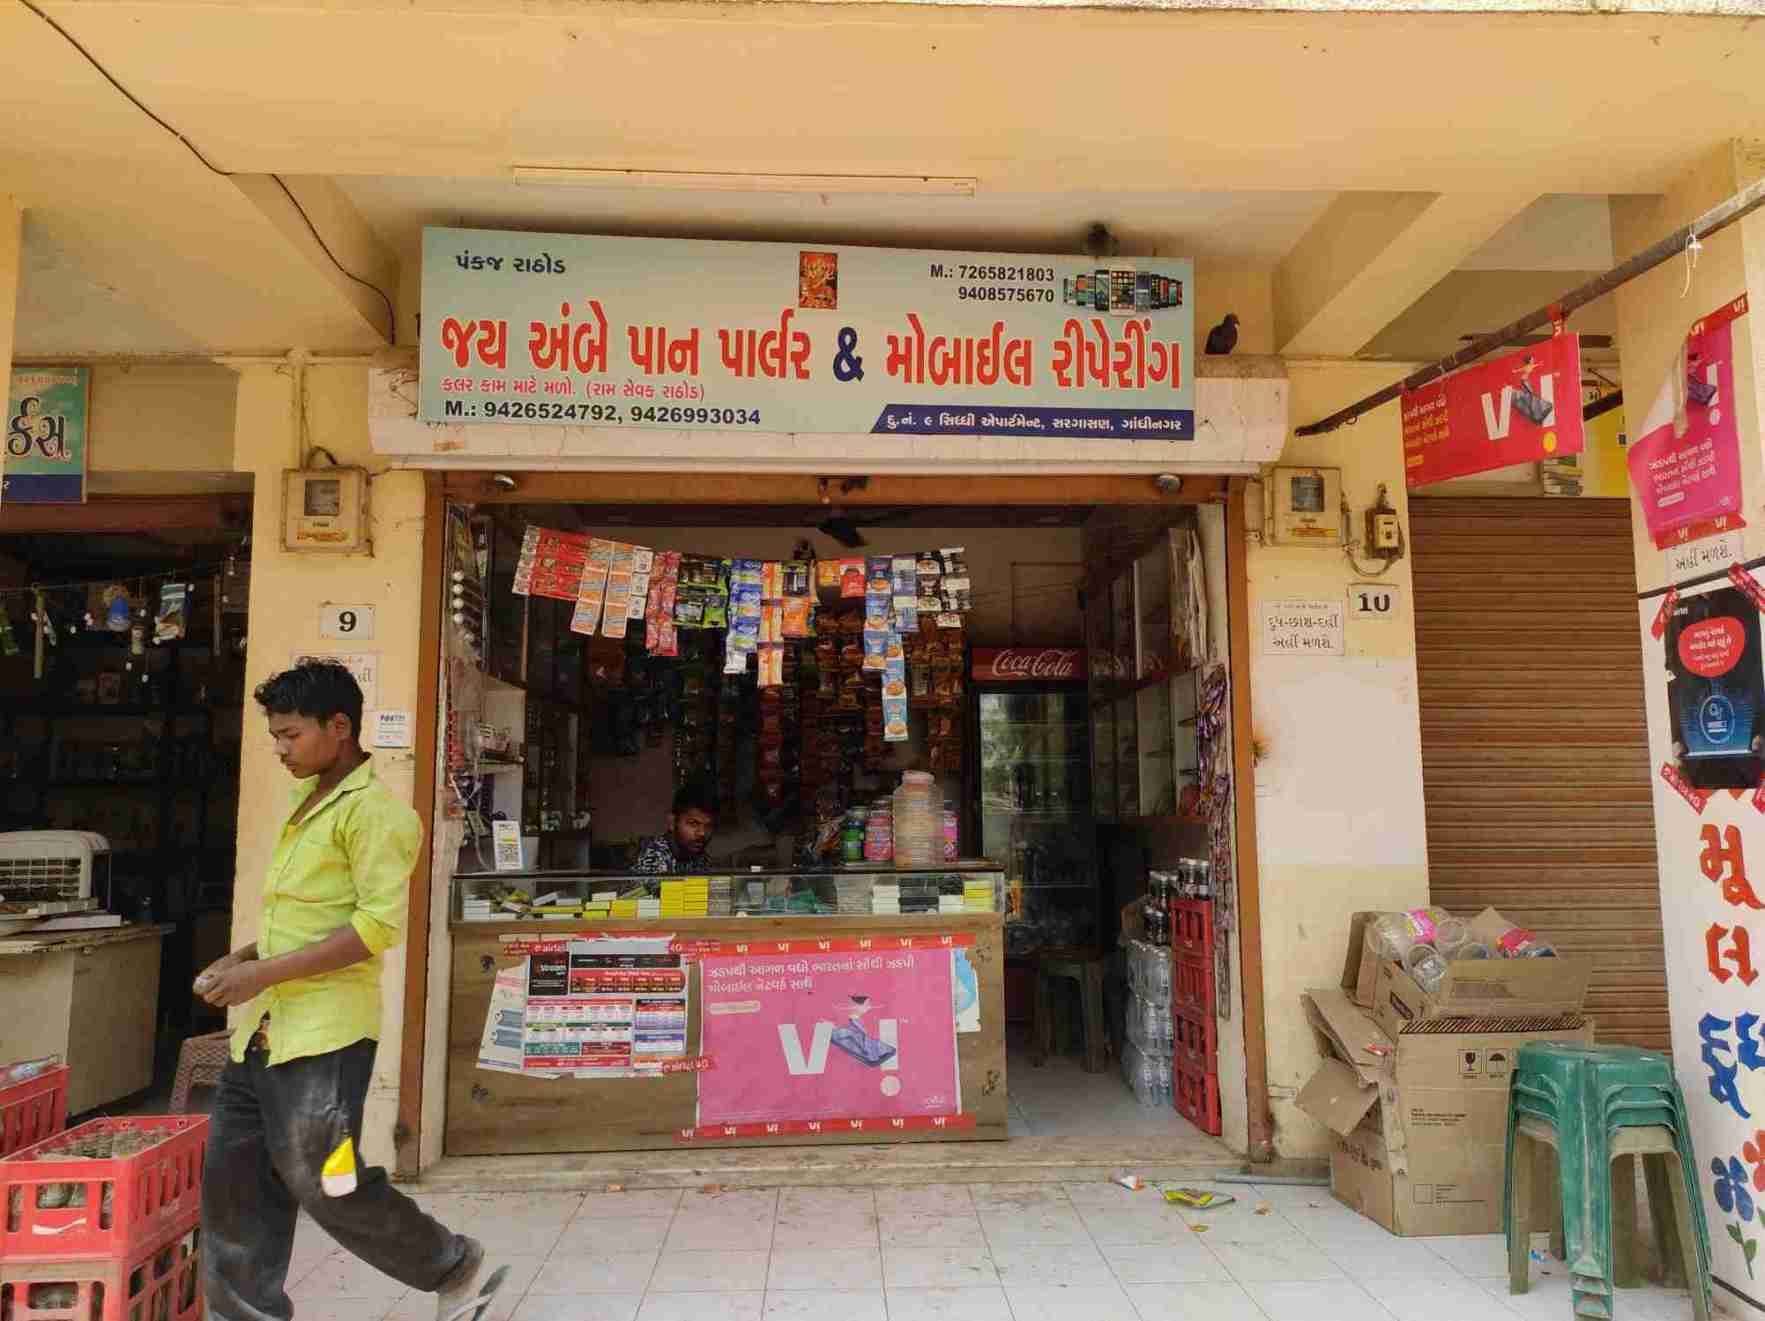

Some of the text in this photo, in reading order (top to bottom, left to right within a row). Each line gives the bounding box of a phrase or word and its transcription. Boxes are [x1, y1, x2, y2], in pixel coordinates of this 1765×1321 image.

[456, 250, 566, 275] પંકજ રાઠોડ
[958, 265, 1055, 282] 7265821803
[958, 286, 1055, 303] 9408575670
[442, 300, 1181, 390] જય અંબે પાન પાર્લર & મોબાઈલ રીપેરીંગ
[443, 378, 473, 392] કલર
[480, 378, 506, 393] કામ
[513, 375, 537, 394] માટે
[544, 376, 576, 396] મળો.
[586, 382, 616, 400] (રામ
[663, 381, 705, 402] રાઠોડ)
[484, 401, 623, 424] 9426524792,
[631, 406, 761, 425] 9426993034
[1121, 416, 1183, 431] ગાંધીનગર
[1358, 592, 1391, 612] 10
[338, 610, 357, 633] 9
